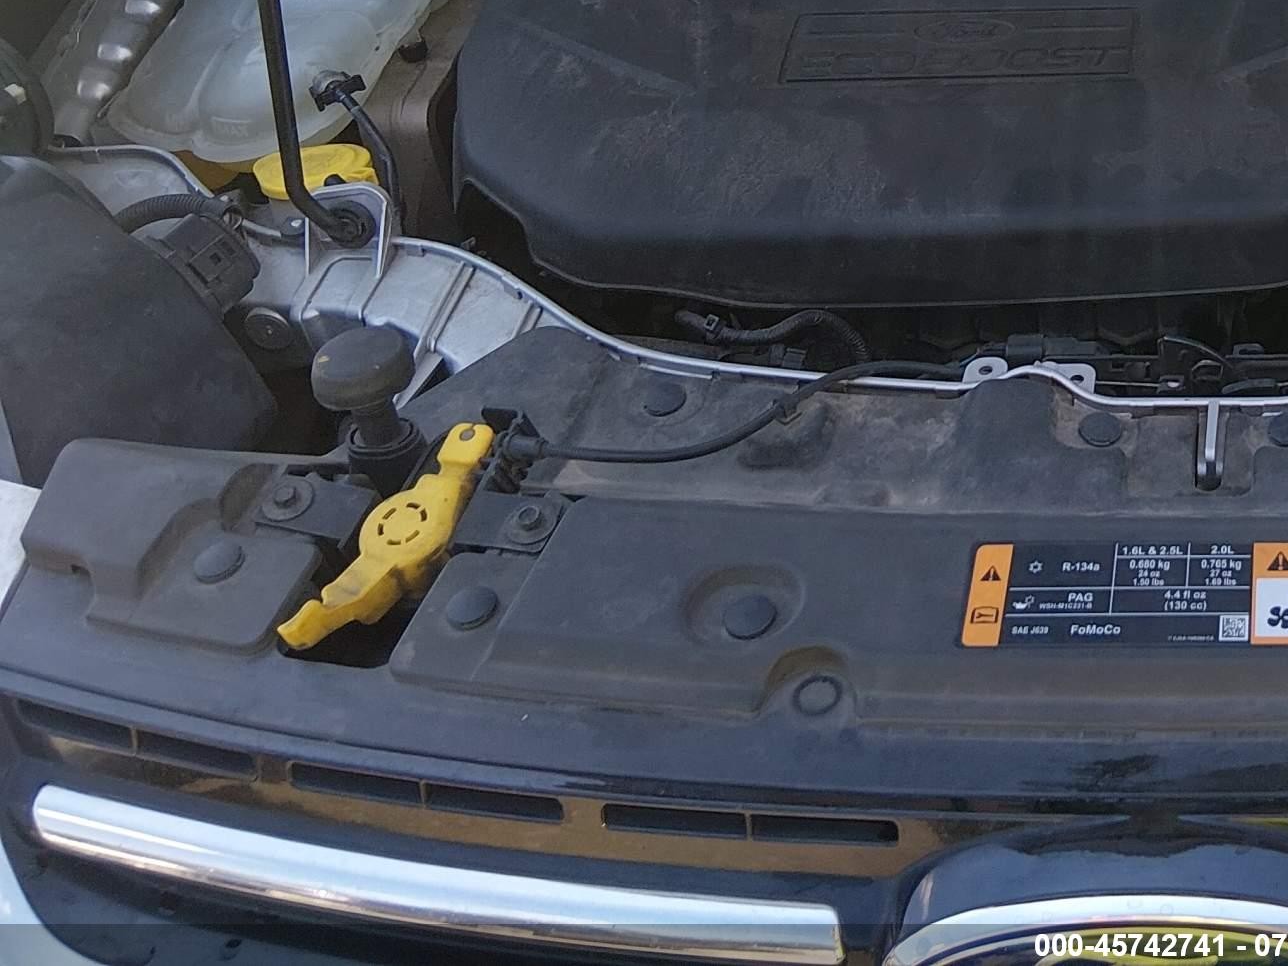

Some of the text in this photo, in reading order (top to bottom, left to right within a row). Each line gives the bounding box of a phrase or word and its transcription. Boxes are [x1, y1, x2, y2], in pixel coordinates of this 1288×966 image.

[1122, 545, 1145, 556] 1.6L
[1148, 545, 1157, 556] &
[1210, 545, 1235, 555] 2.0L
[1061, 561, 1101, 572] R-134a
[1129, 559, 1171, 572] 0.680 kg
[1200, 559, 1242, 571] 0.765 kg
[1138, 570, 1161, 578] 24 oz
[1209, 569, 1233, 578] 27 oz
[1151, 578, 1165, 587] lbs
[1223, 578, 1237, 587] lbs
[1068, 592, 1094, 603] PAG
[1163, 590, 1207, 600] 4.4 fl oz
[1163, 600, 1208, 611] (130 cc)
[1011, 625, 1049, 635] SAE J639
[1070, 624, 1121, 636] FoMoCo
